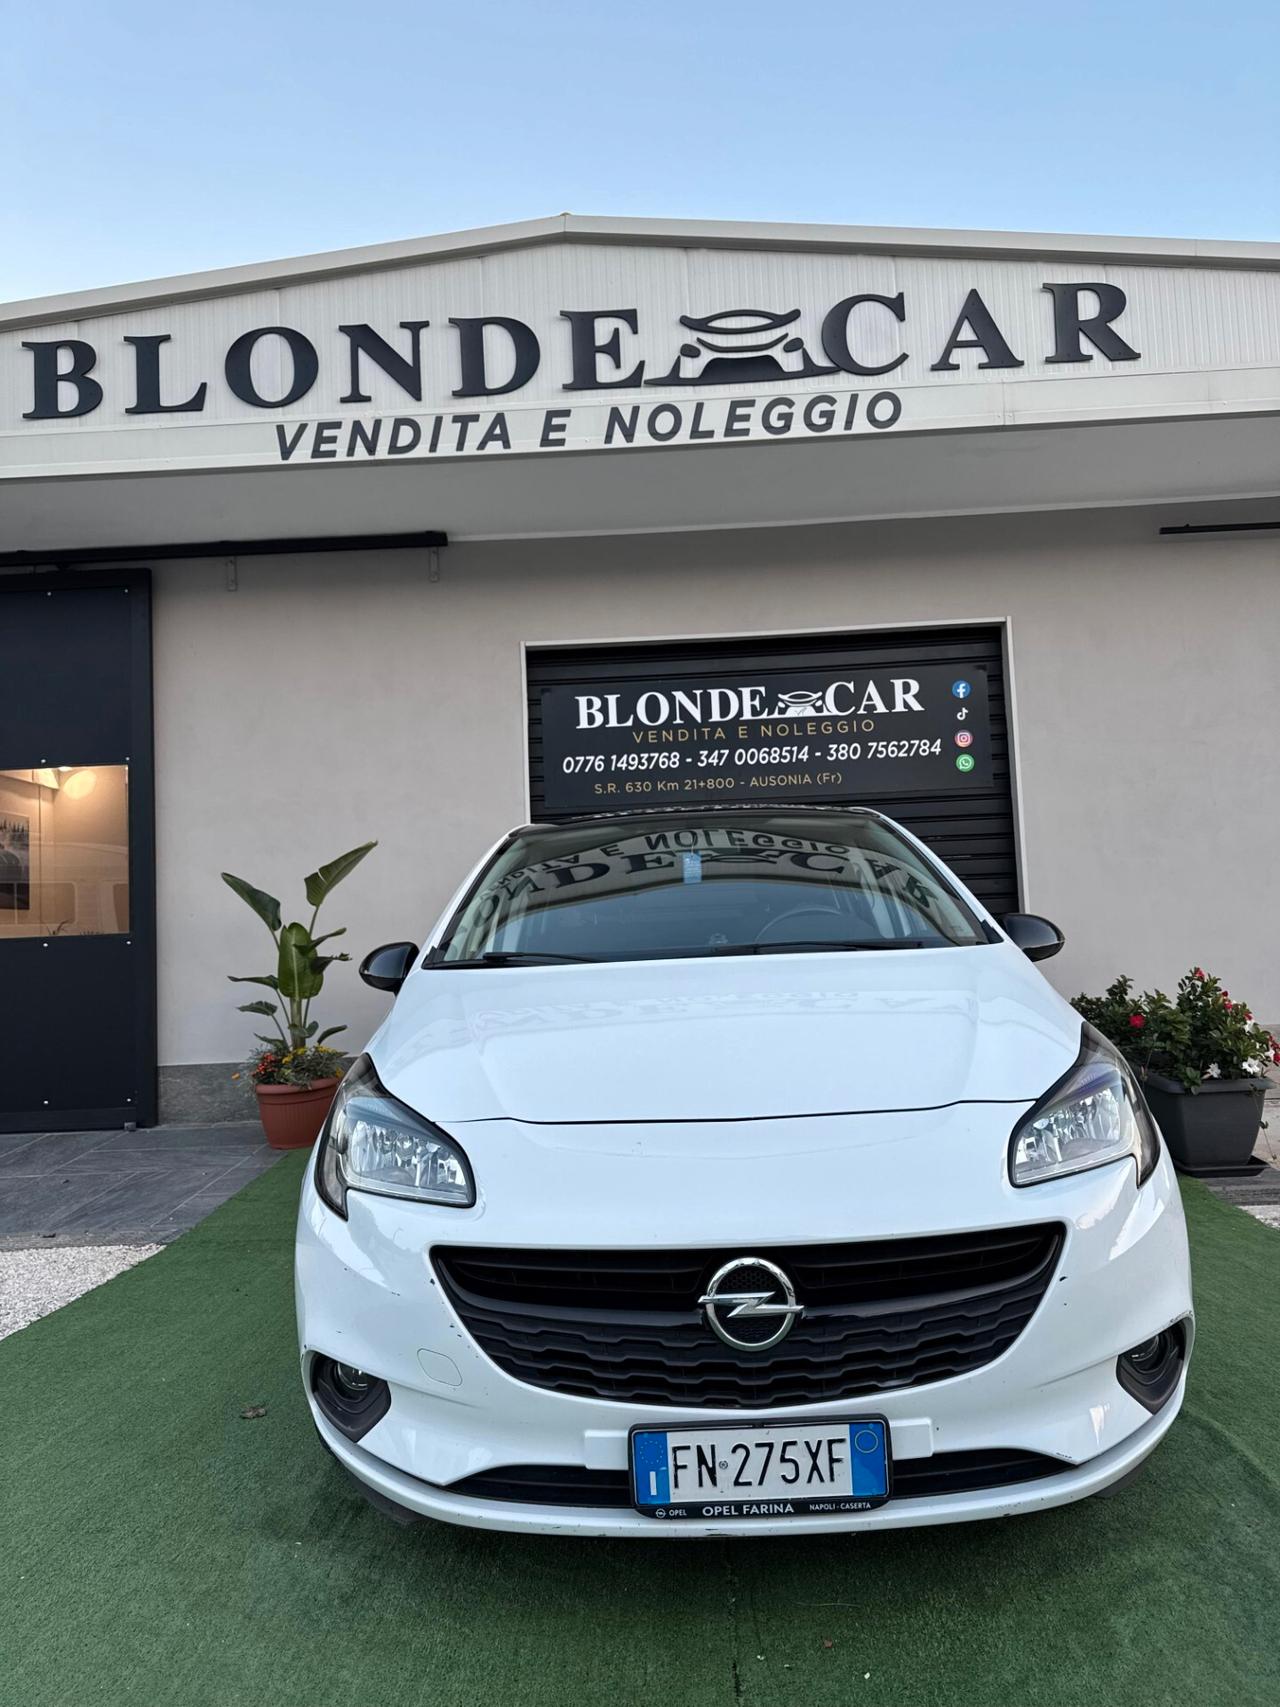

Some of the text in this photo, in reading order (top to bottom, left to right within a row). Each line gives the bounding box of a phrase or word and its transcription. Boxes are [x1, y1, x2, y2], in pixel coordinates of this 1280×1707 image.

[21, 282, 1142, 420] BLONDE CAR
[276, 390, 902, 461] VENDITA E NOLEGGIO
[574, 678, 926, 730] BLONDE CAR
[632, 719, 875, 744] VENDITA E NOLEGGIO
[562, 755, 605, 774] 0776
[610, 751, 681, 771] 1493768
[697, 749, 730, 767] 347
[734, 745, 809, 766] 0068514
[827, 742, 861, 761] 380
[867, 738, 942, 759] 7562784
[594, 782, 620, 795] S.R.
[625, 780, 652, 793] 630
[657, 779, 679, 791] Km
[684, 777, 735, 790] 21+800
[749, 773, 812, 787] AUSONIA
[816, 771, 843, 785] (Fr)
[702, 1503, 795, 1517] OPEL FARINA
[809, 1503, 836, 1511] NAPOLI
[840, 1502, 871, 1510] CASERTA
